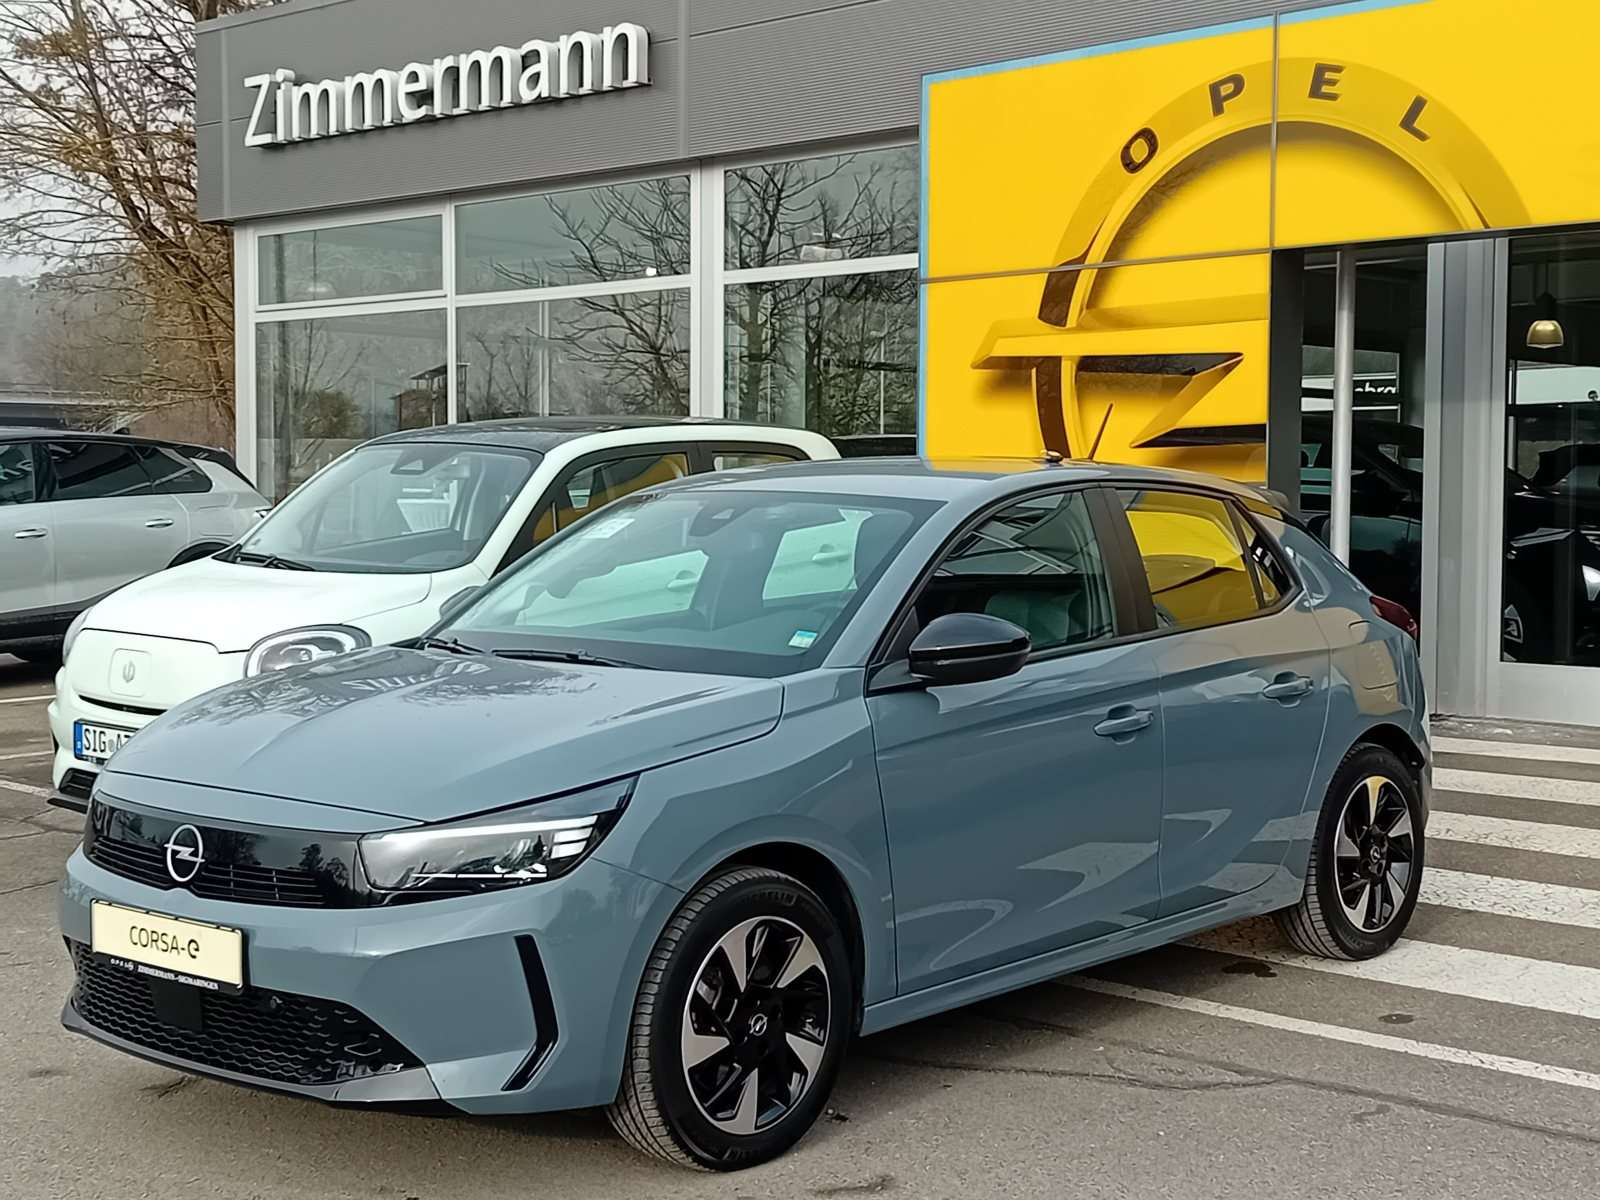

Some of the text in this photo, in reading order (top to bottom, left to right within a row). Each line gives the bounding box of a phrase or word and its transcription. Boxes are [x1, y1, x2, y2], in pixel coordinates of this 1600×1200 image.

[244, 22, 651, 147] Zimmermann
[1120, 63, 1430, 174] OPEL
[83, 727, 107, 753] SIG
[129, 925, 200, 959] CORSA-e
